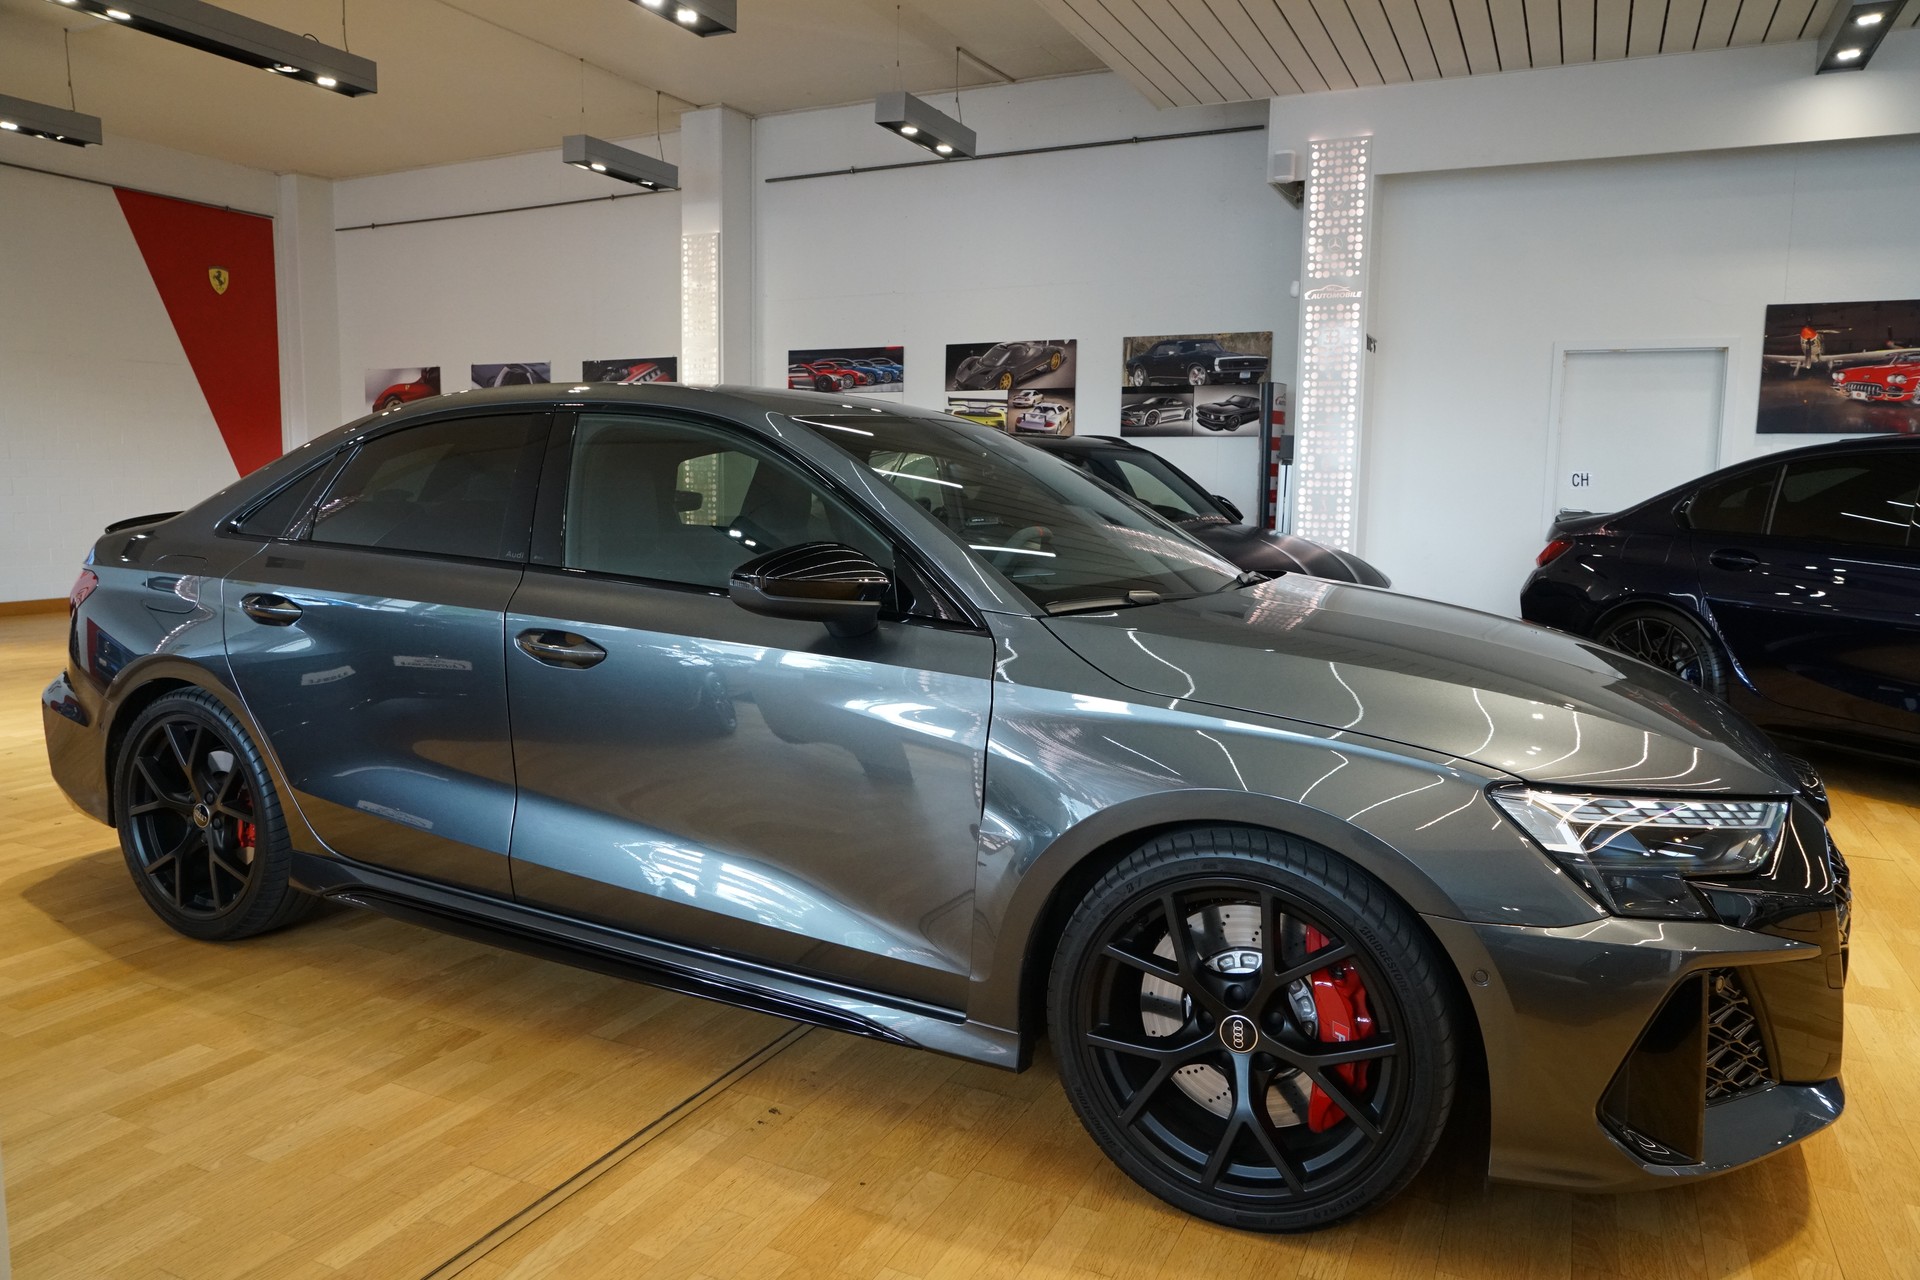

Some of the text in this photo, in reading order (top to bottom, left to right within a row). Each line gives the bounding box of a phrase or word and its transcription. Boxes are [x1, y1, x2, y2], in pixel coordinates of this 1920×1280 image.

[1311, 291, 1362, 300] AUTOMOBILE
[1572, 473, 1589, 487] CH
[506, 550, 525, 559] Audi
[1359, 926, 1410, 994] BRIDGESTONE
